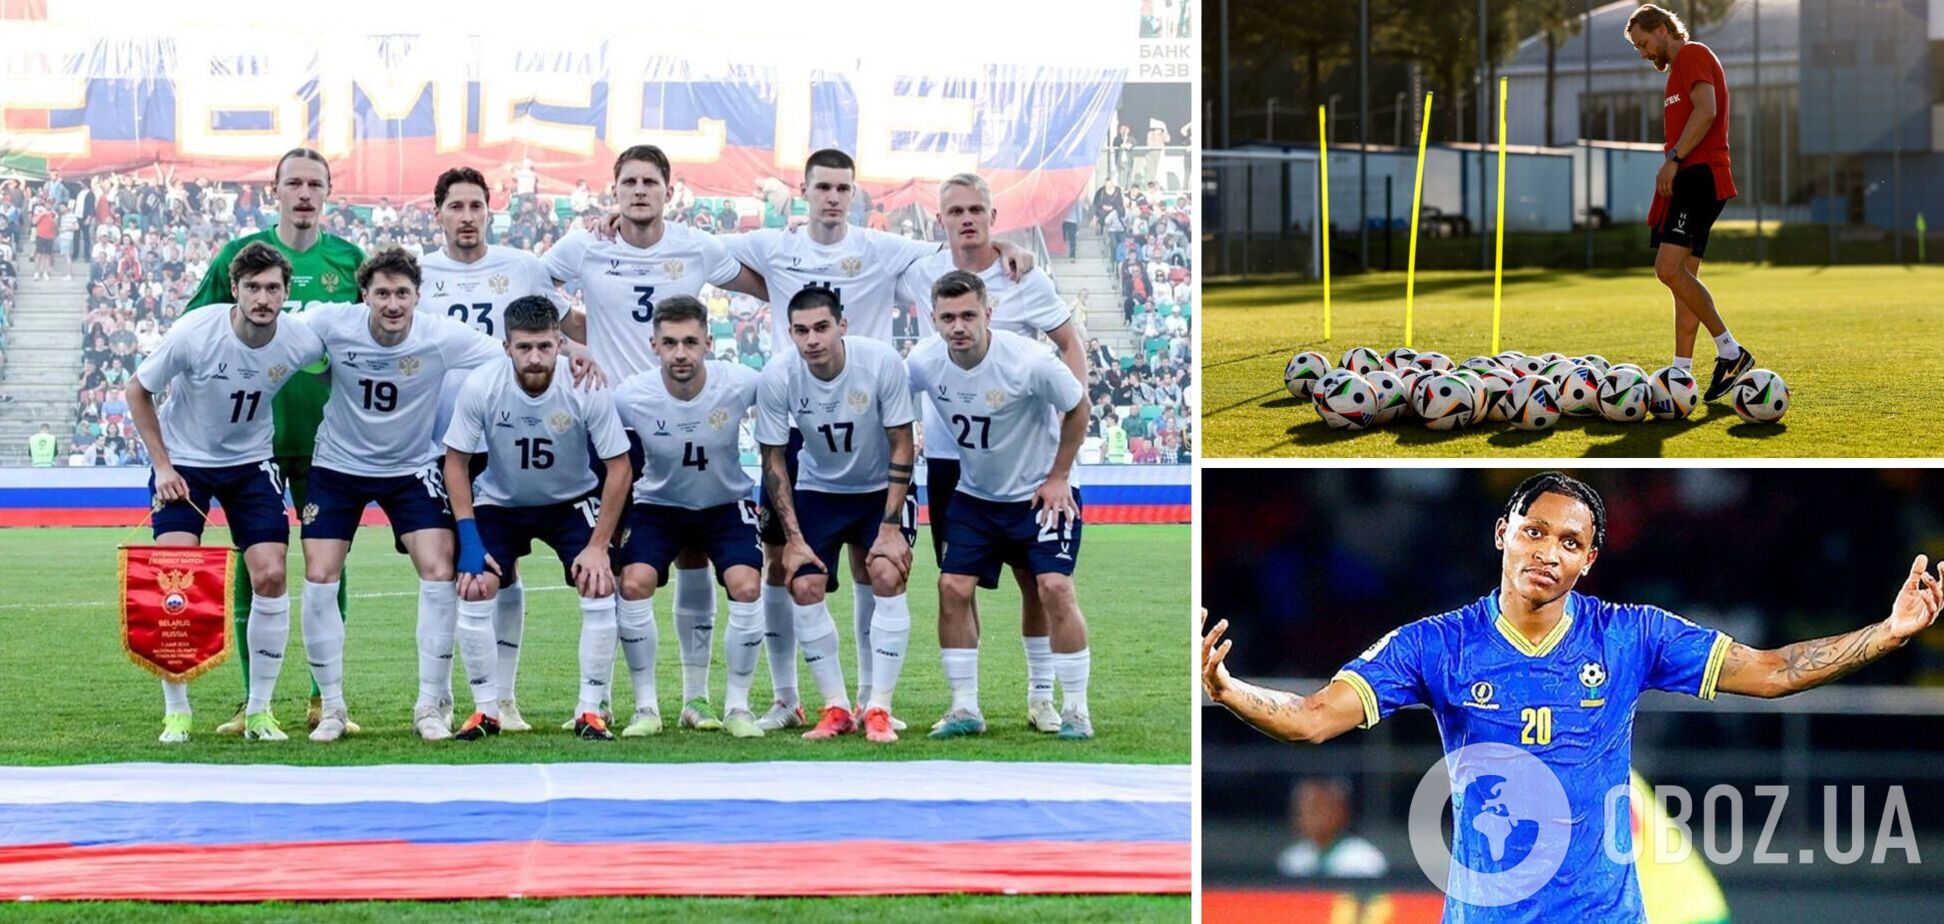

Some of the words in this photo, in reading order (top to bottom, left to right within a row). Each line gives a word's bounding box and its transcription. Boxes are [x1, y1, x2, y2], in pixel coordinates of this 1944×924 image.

[1139, 44, 1191, 59] БАНК
[1139, 63, 1189, 78] РАЗВ
[172, 20, 980, 184] ВМЕСТЕ
[632, 286, 655, 323] 3
[230, 390, 262, 424] 11
[358, 379, 399, 413] 19
[817, 421, 854, 453] 17
[951, 414, 992, 450] 27
[514, 437, 555, 470] 15
[682, 441, 709, 472] 4
[1521, 706, 1552, 746] 20
